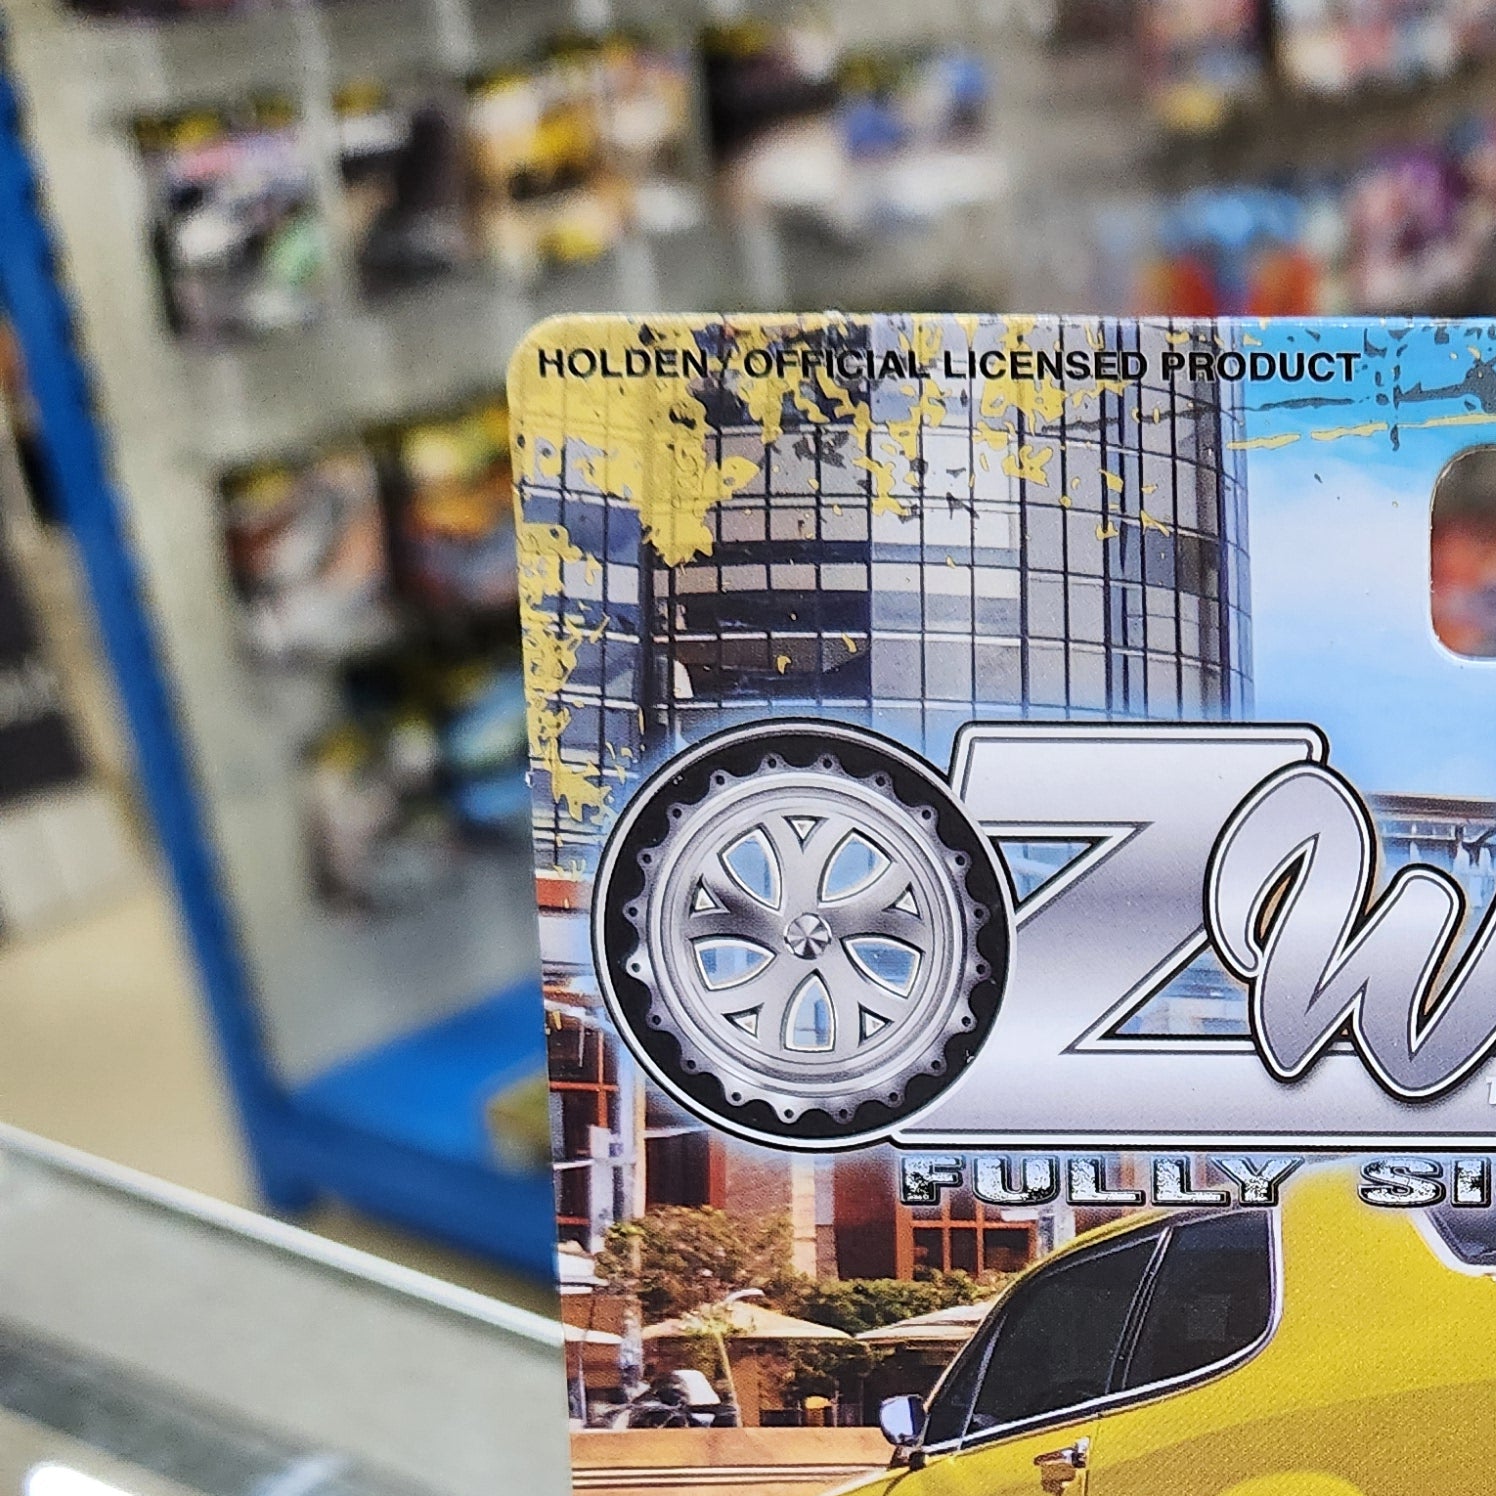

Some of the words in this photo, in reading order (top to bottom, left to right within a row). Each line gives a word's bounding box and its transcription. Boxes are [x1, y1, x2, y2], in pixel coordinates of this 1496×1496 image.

[538, 347, 708, 379] HOLDEN
[744, 348, 931, 381] OFFICIAL
[943, 349, 1148, 382] LICENSED
[1161, 351, 1361, 382] PRODUCT
[900, 1154, 1306, 1206] FULLY
